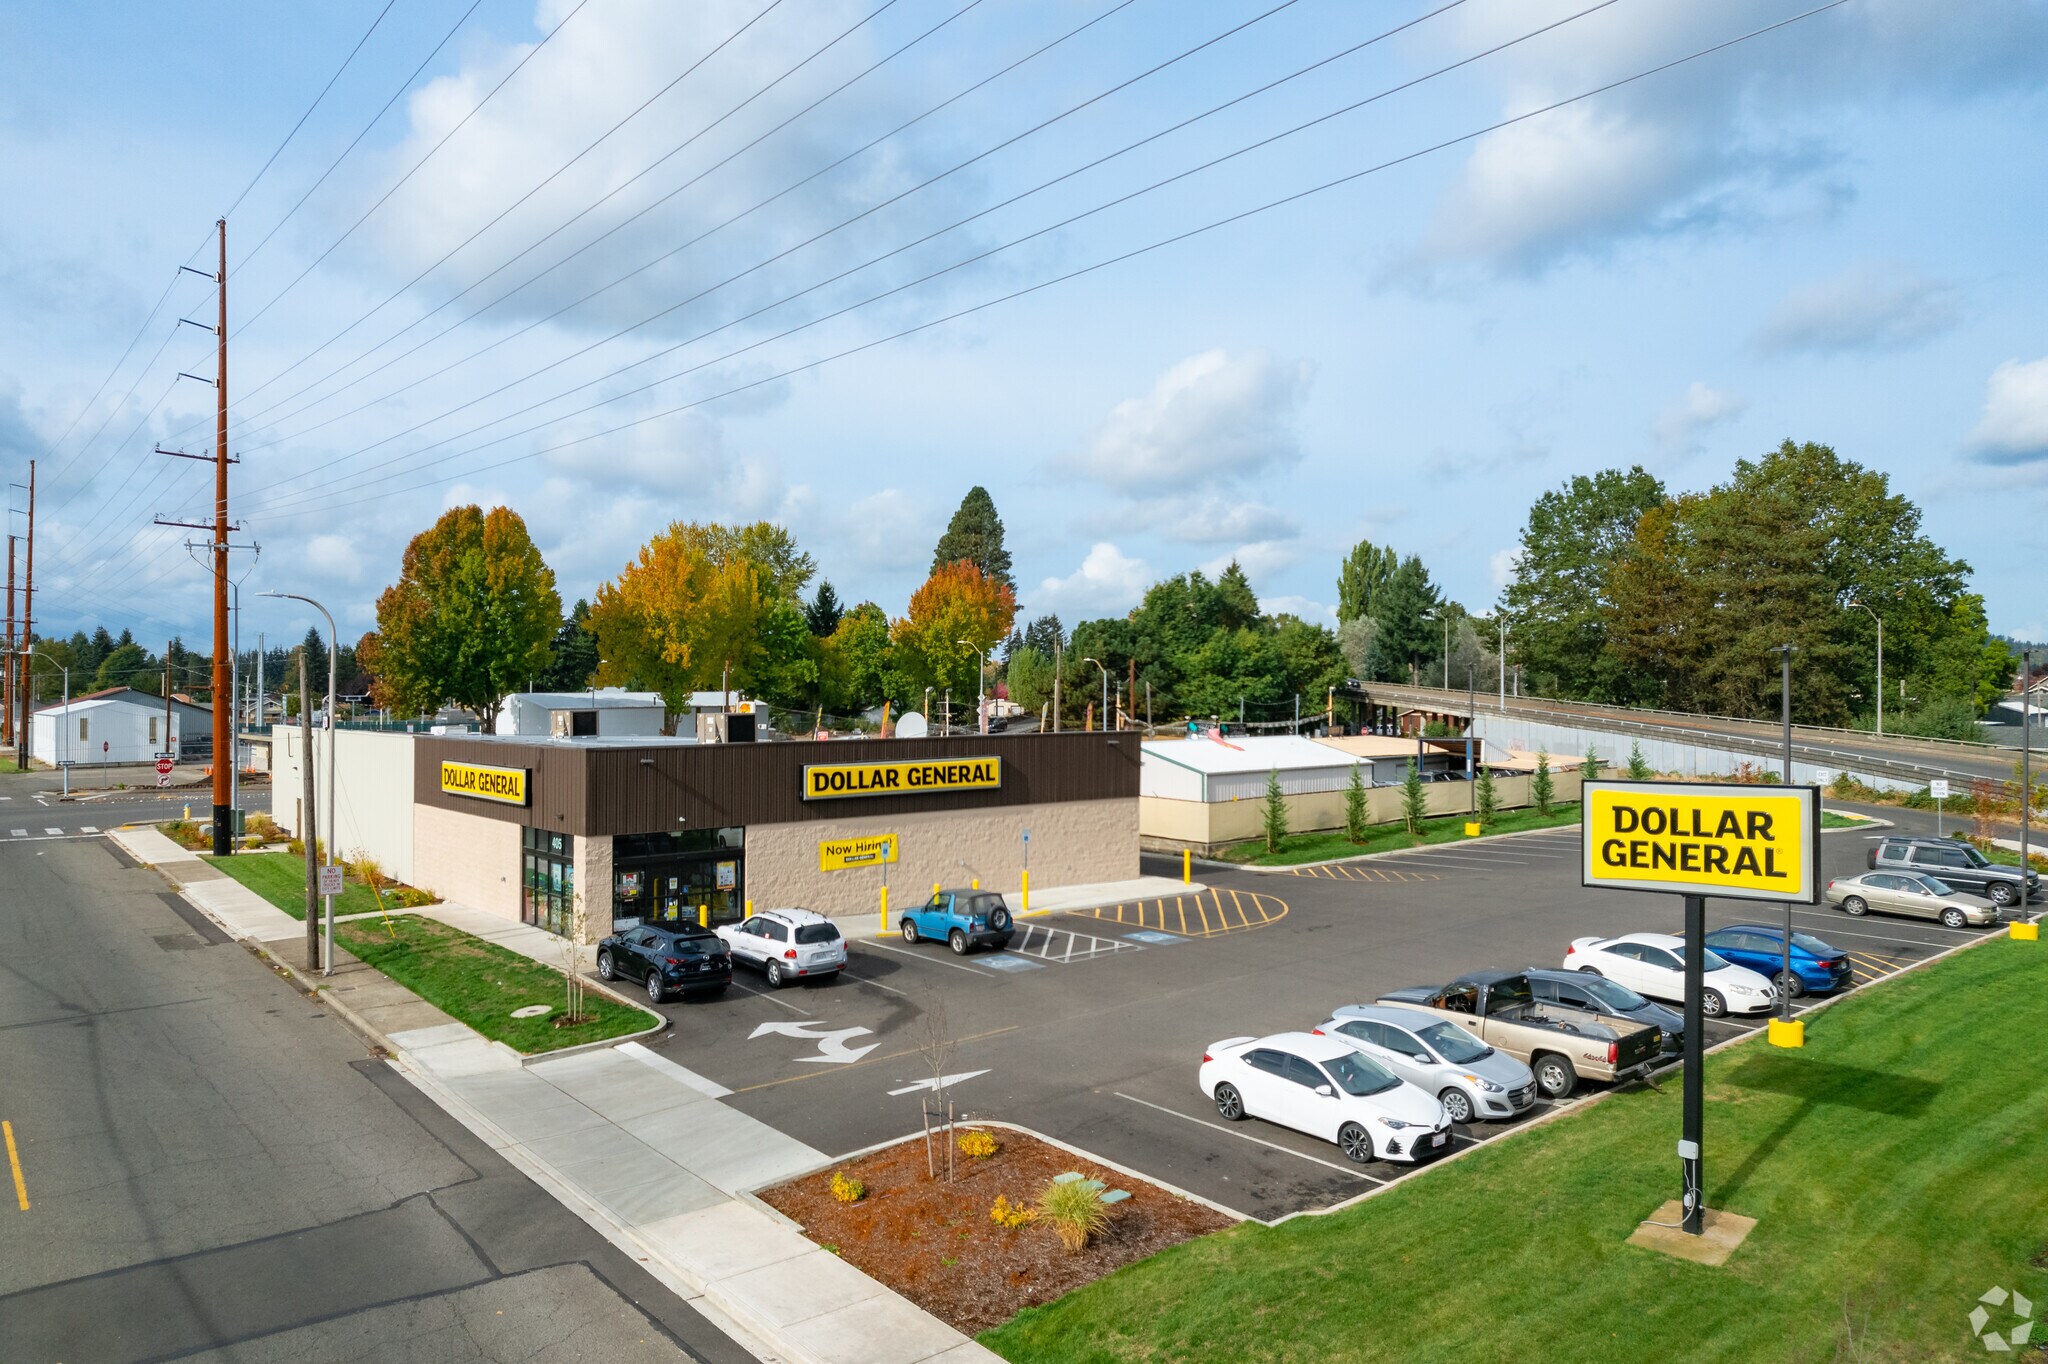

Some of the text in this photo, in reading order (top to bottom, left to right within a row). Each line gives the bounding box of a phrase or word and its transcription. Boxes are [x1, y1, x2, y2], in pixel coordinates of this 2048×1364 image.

[444, 768, 520, 797] DOLLAR GENERAL
[813, 764, 996, 792] DOLLAR GENERAL
[1612, 805, 1775, 841] DOLLAR
[552, 836, 563, 850] 405
[826, 838, 892, 856] Now Hirin!
